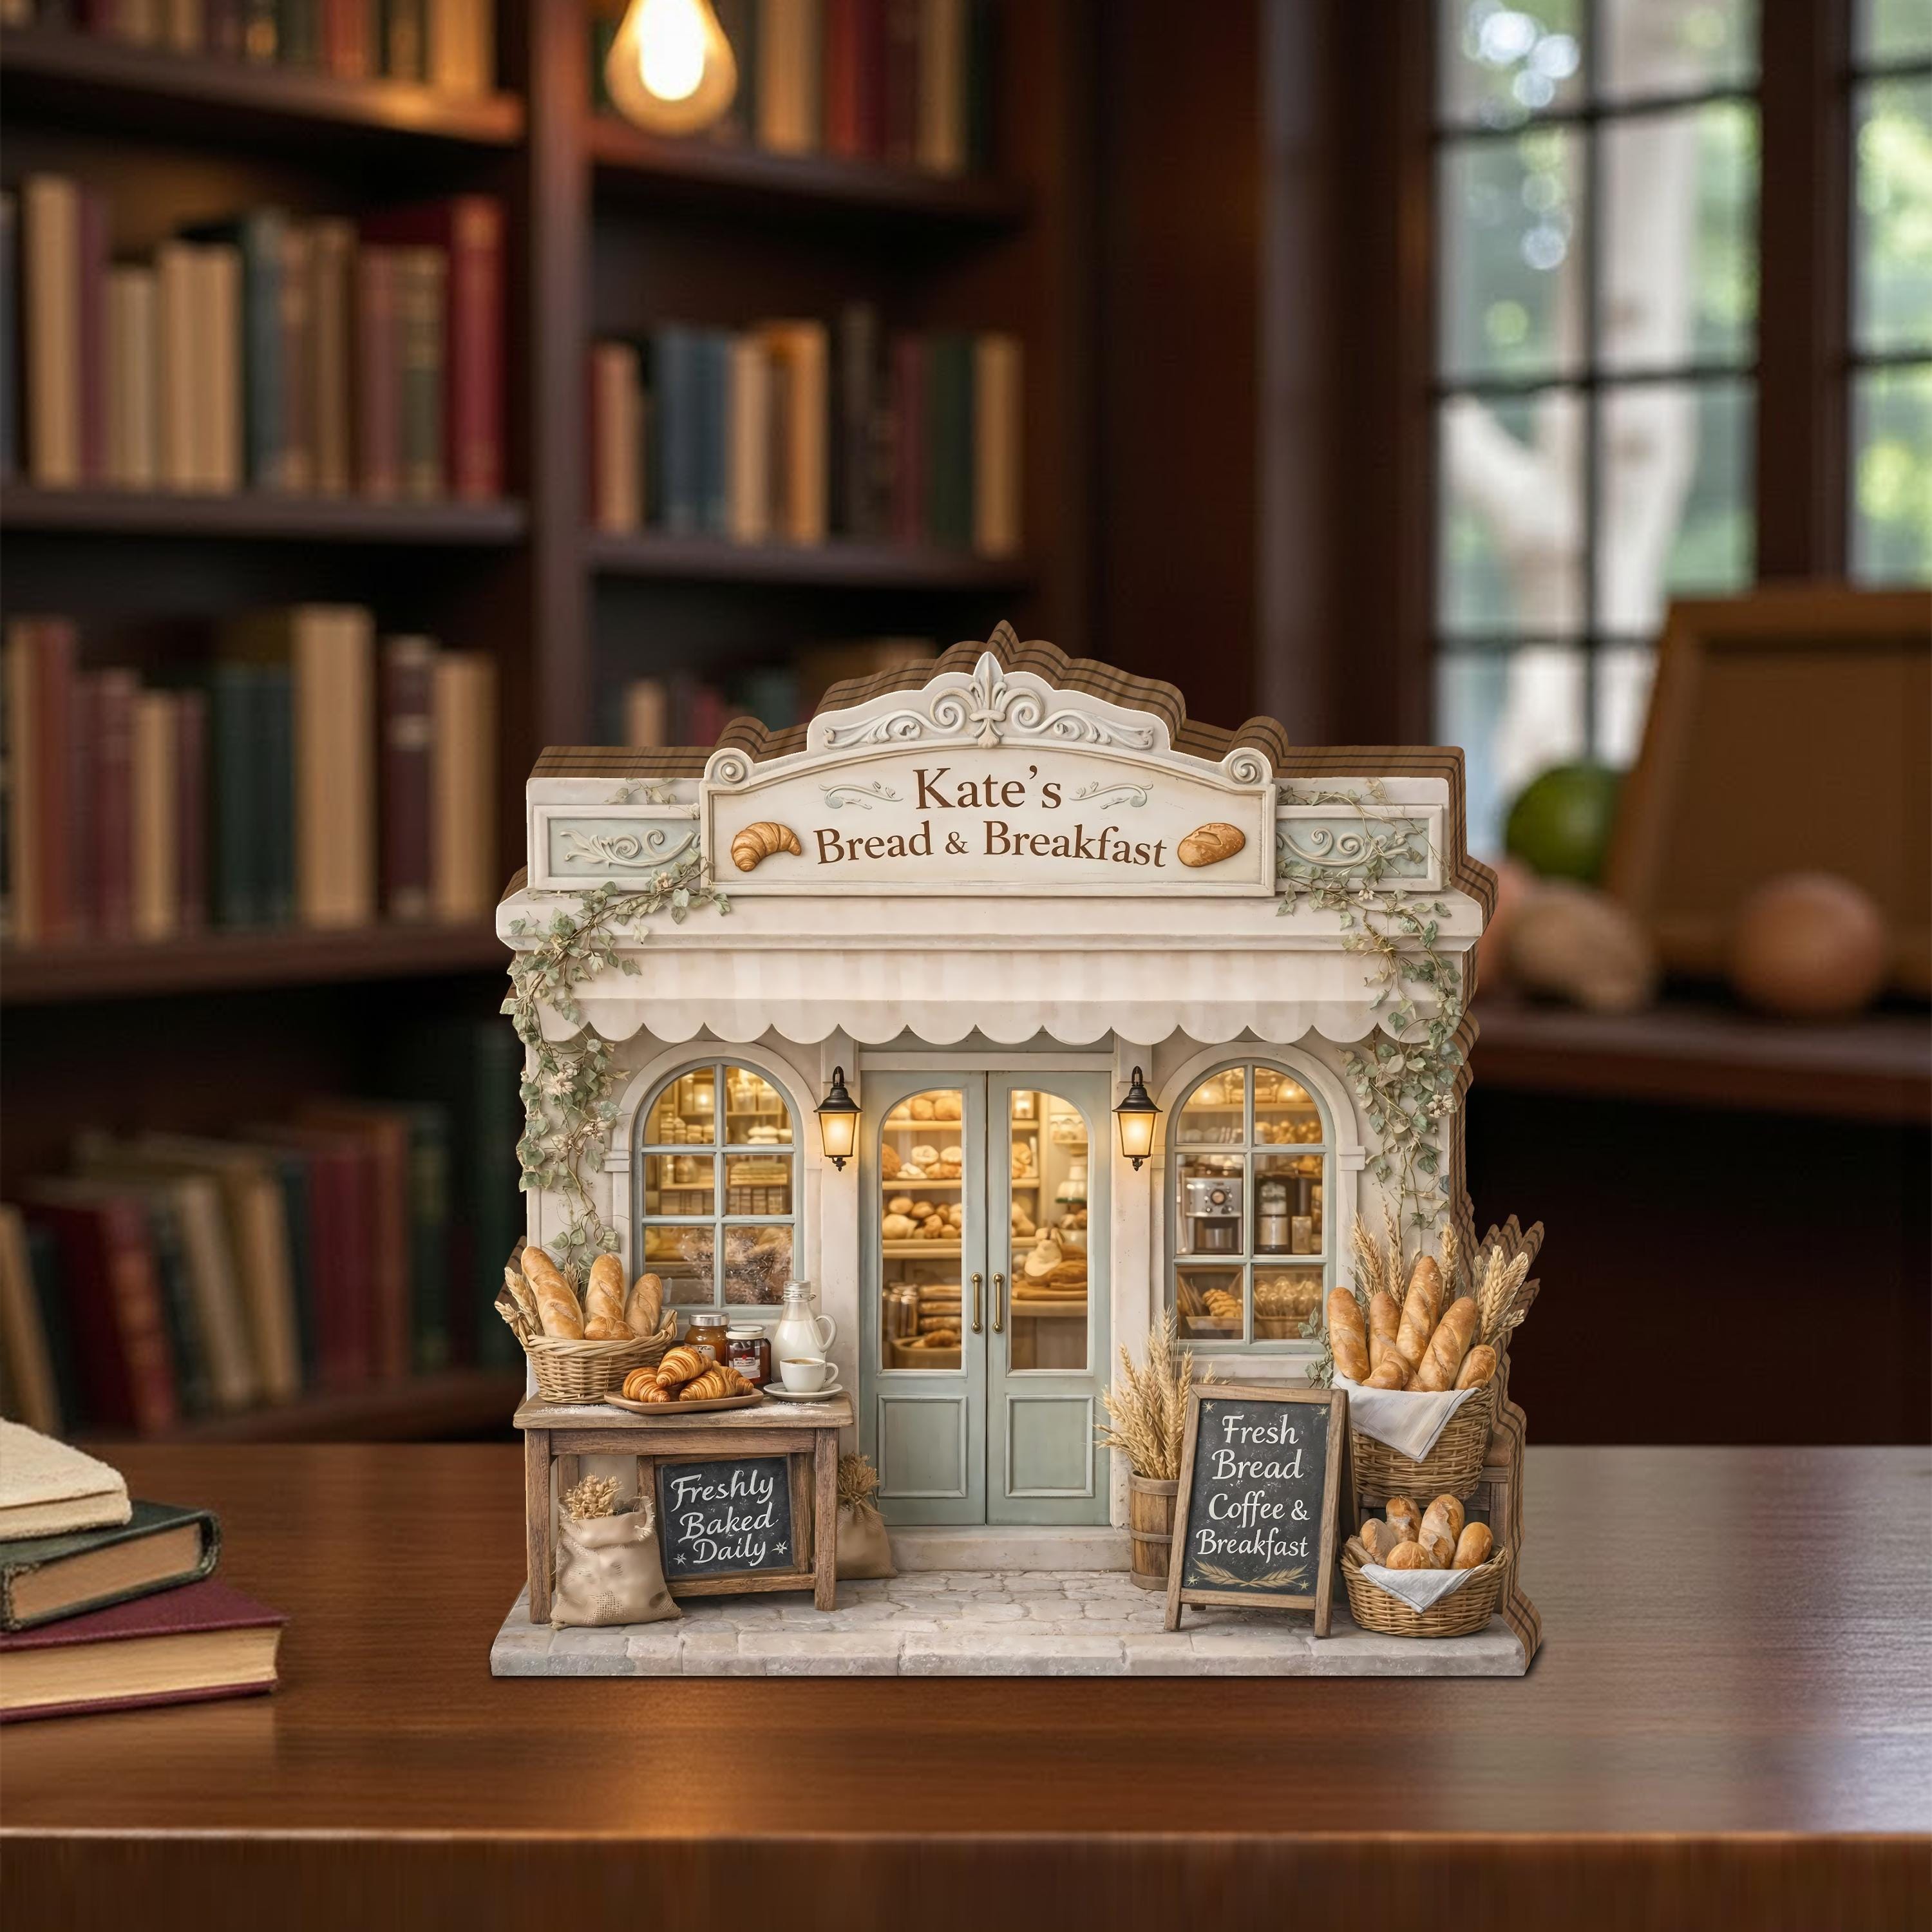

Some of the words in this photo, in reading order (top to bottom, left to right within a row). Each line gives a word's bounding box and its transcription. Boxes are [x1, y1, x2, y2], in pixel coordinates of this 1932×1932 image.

[913, 765, 1062, 810] Kate's
[813, 820, 934, 865] Bread
[945, 831, 969, 855] &
[983, 820, 1168, 868] Breakfast
[1222, 1414, 1299, 1444] Fresh
[1211, 1449, 1304, 1479] Bread
[670, 1469, 773, 1512] Freshly
[1208, 1490, 1285, 1528] Coffee
[1291, 1499, 1311, 1520] &
[677, 1501, 779, 1544] Baked
[693, 1533, 766, 1566] Daily
[1196, 1527, 1309, 1564] Breakfast
